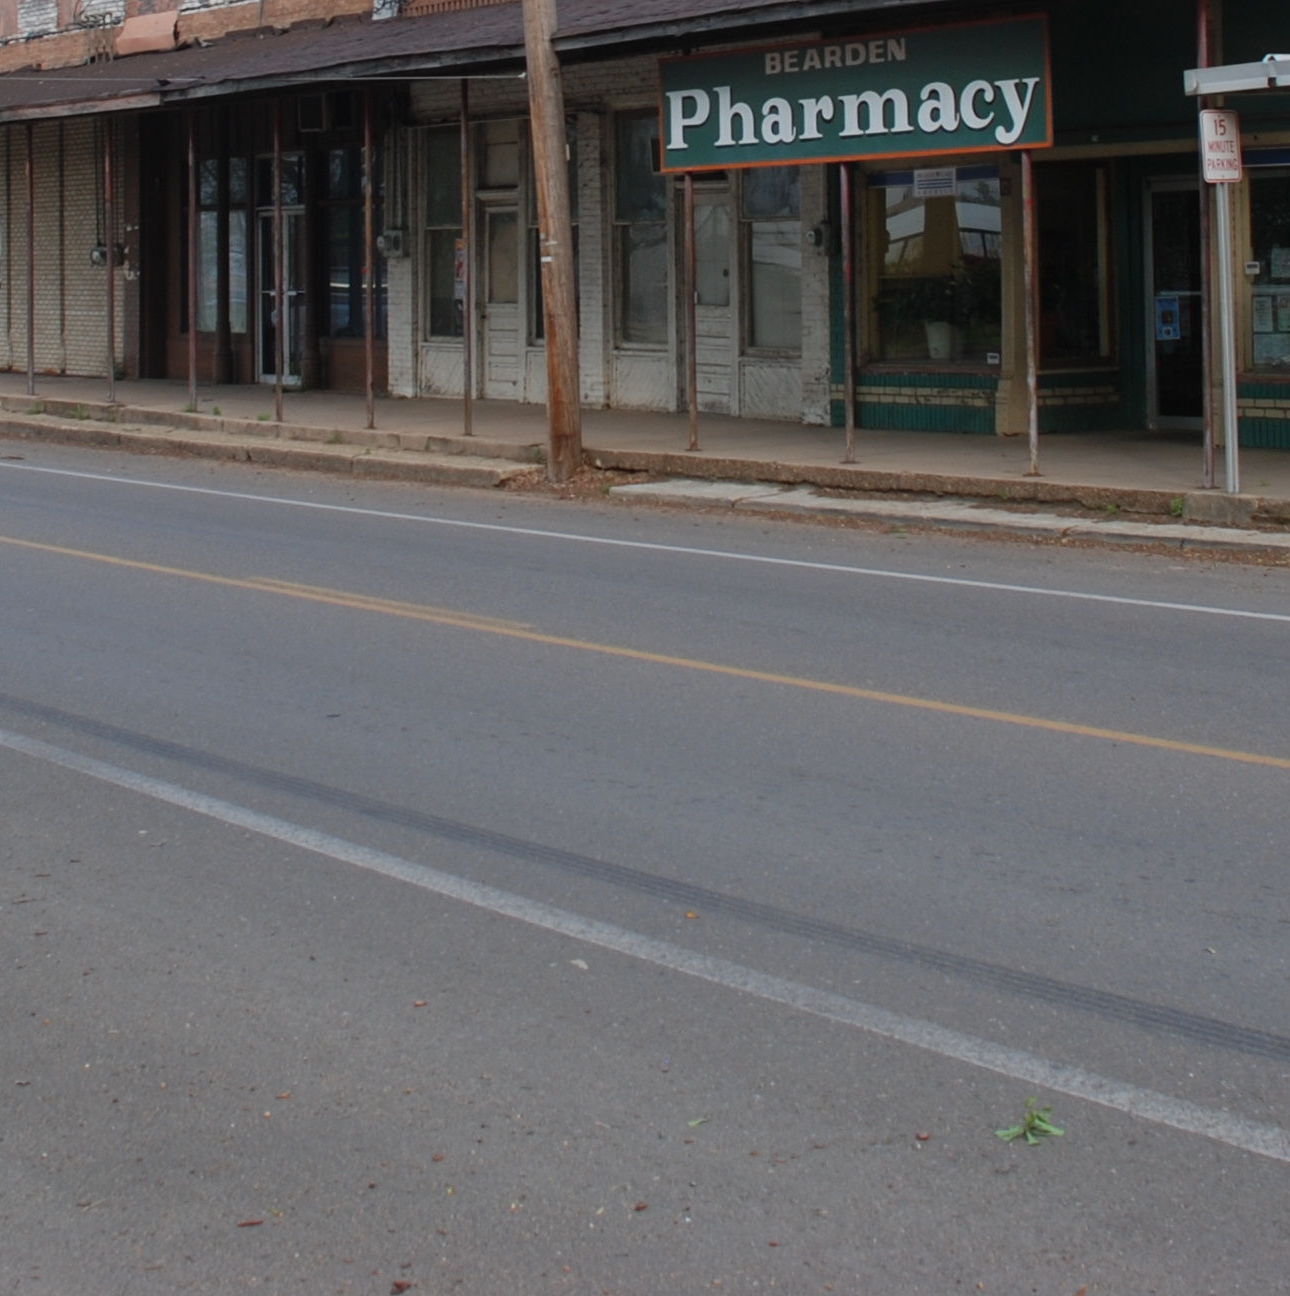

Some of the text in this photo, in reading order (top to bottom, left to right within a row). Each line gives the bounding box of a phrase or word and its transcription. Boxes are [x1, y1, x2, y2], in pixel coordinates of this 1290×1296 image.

[765, 38, 907, 75] BEARDEN
[665, 77, 1041, 150] Pharmacy
[1214, 119, 1226, 136] 15
[1208, 140, 1235, 153] MINUTE
[1207, 158, 1238, 171] PARKING
